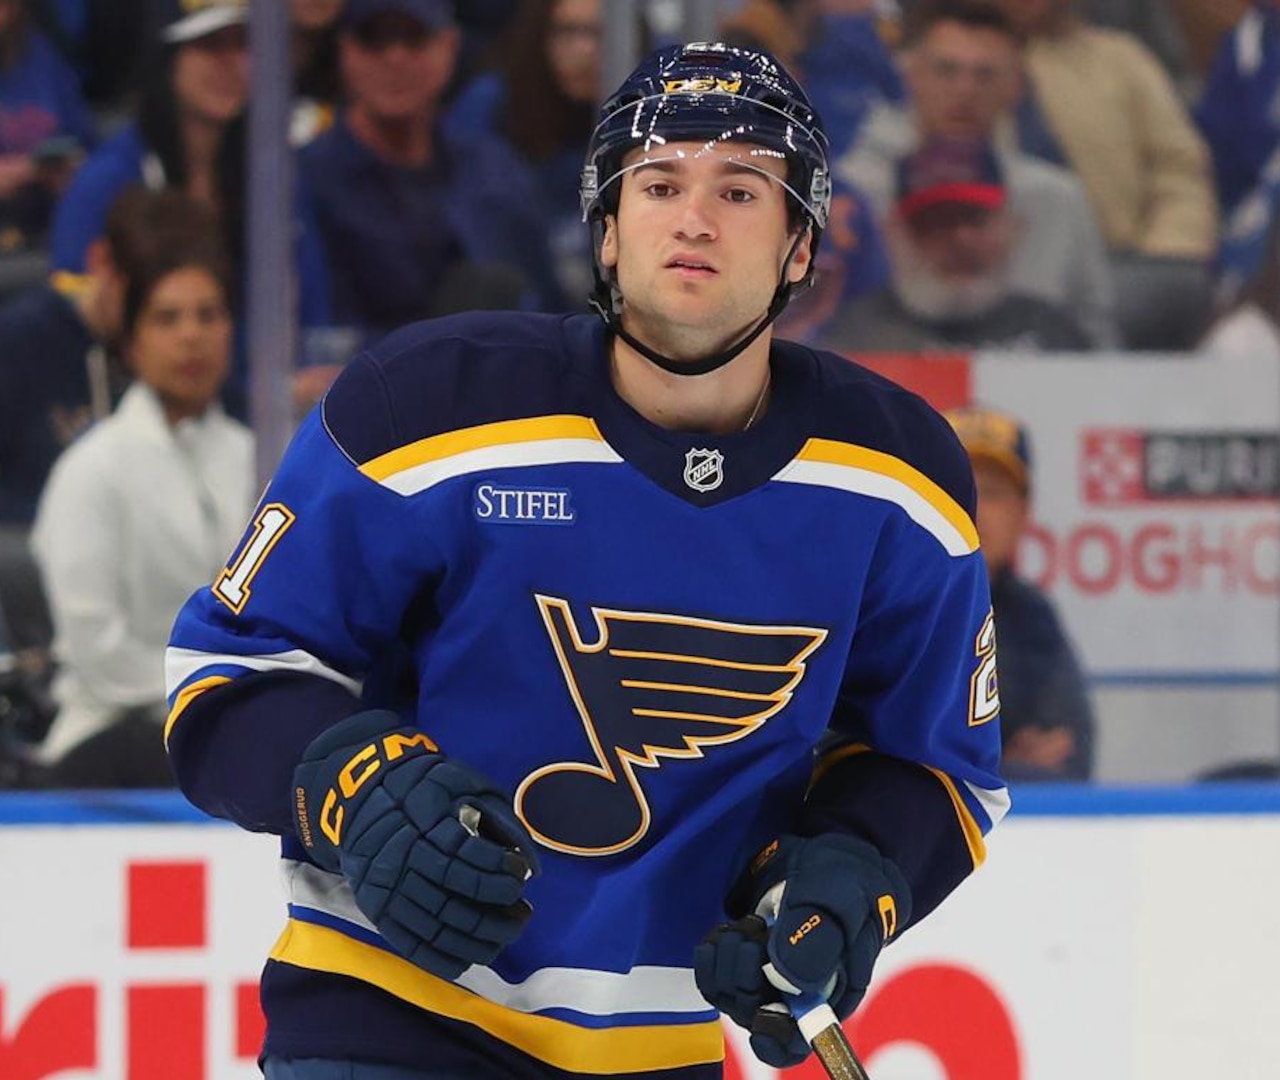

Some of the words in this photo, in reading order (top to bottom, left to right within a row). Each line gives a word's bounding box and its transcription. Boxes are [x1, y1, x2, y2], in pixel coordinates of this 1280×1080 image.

[693, 459, 717, 481] NHL
[476, 485, 573, 520] STIFEL
[211, 502, 296, 615] 1
[320, 732, 440, 846] CCM
[789, 914, 821, 945] CCM
